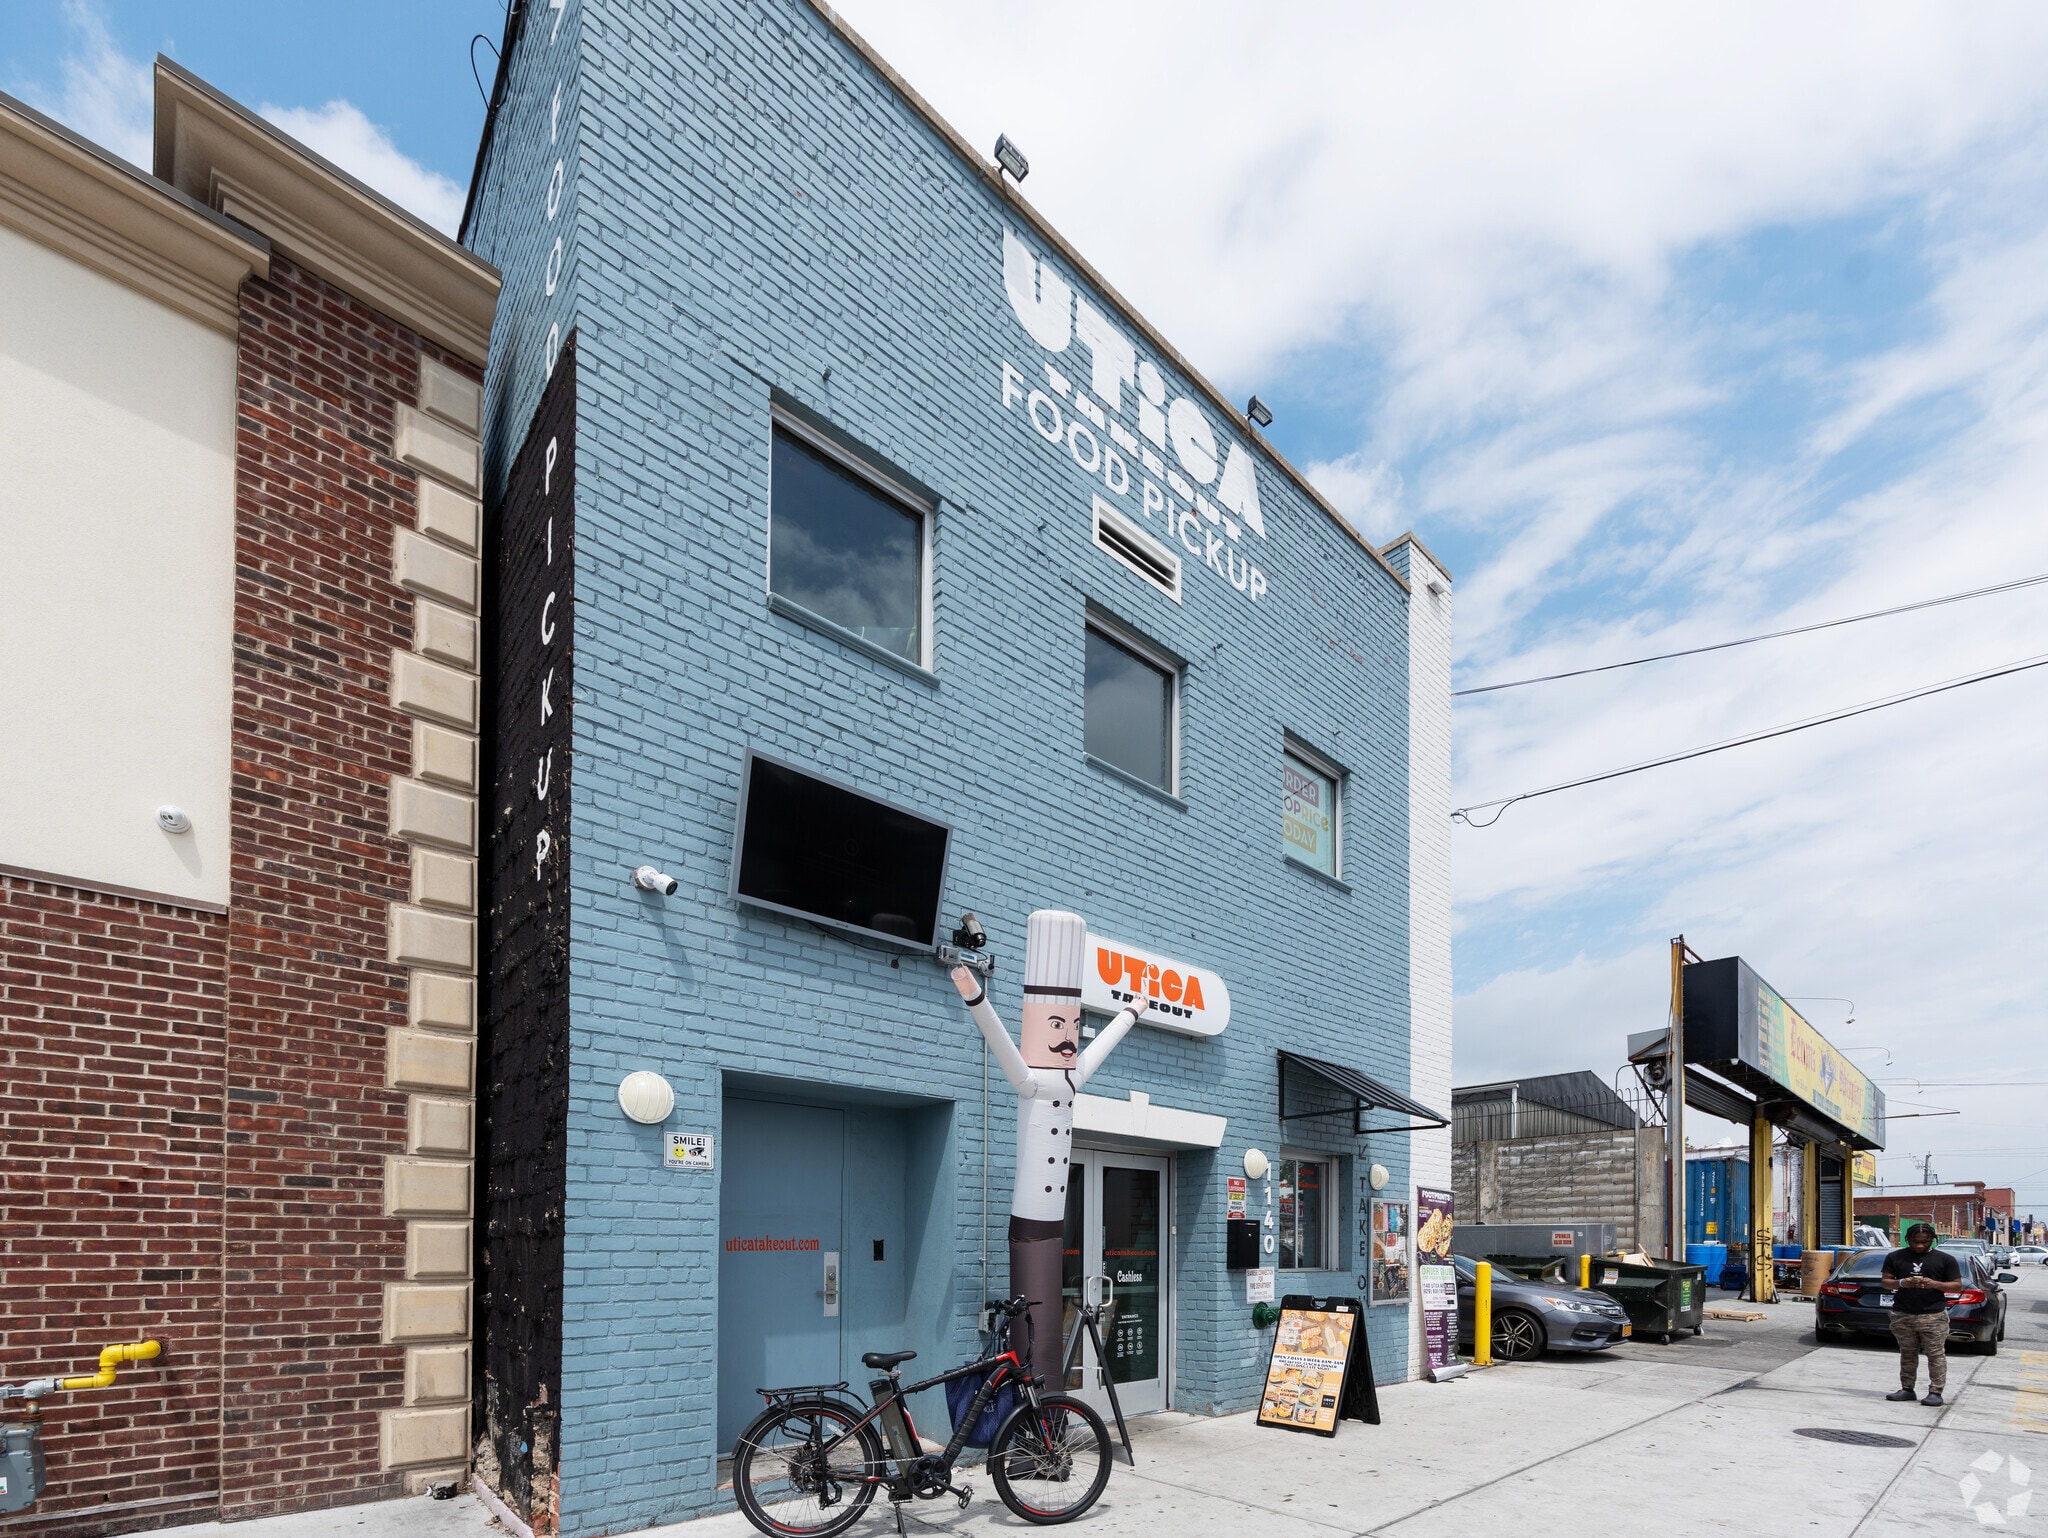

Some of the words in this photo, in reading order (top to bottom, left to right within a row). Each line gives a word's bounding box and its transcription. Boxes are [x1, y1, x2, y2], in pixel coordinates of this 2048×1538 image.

[1044, 360, 1242, 544] TAKEOUT
[1002, 360, 1130, 495] FOOD
[1143, 479, 1267, 603] PICKUP
[536, 436, 557, 881] PICKUP
[1283, 770, 1316, 803] RDER
[1110, 989, 1193, 1019] TAEOUT
[673, 1136, 706, 1146] SMILE!
[1264, 1162, 1275, 1254] 1140
[725, 1235, 820, 1252] uticatakeout.com
[1117, 1270, 1143, 1283] Cashless
